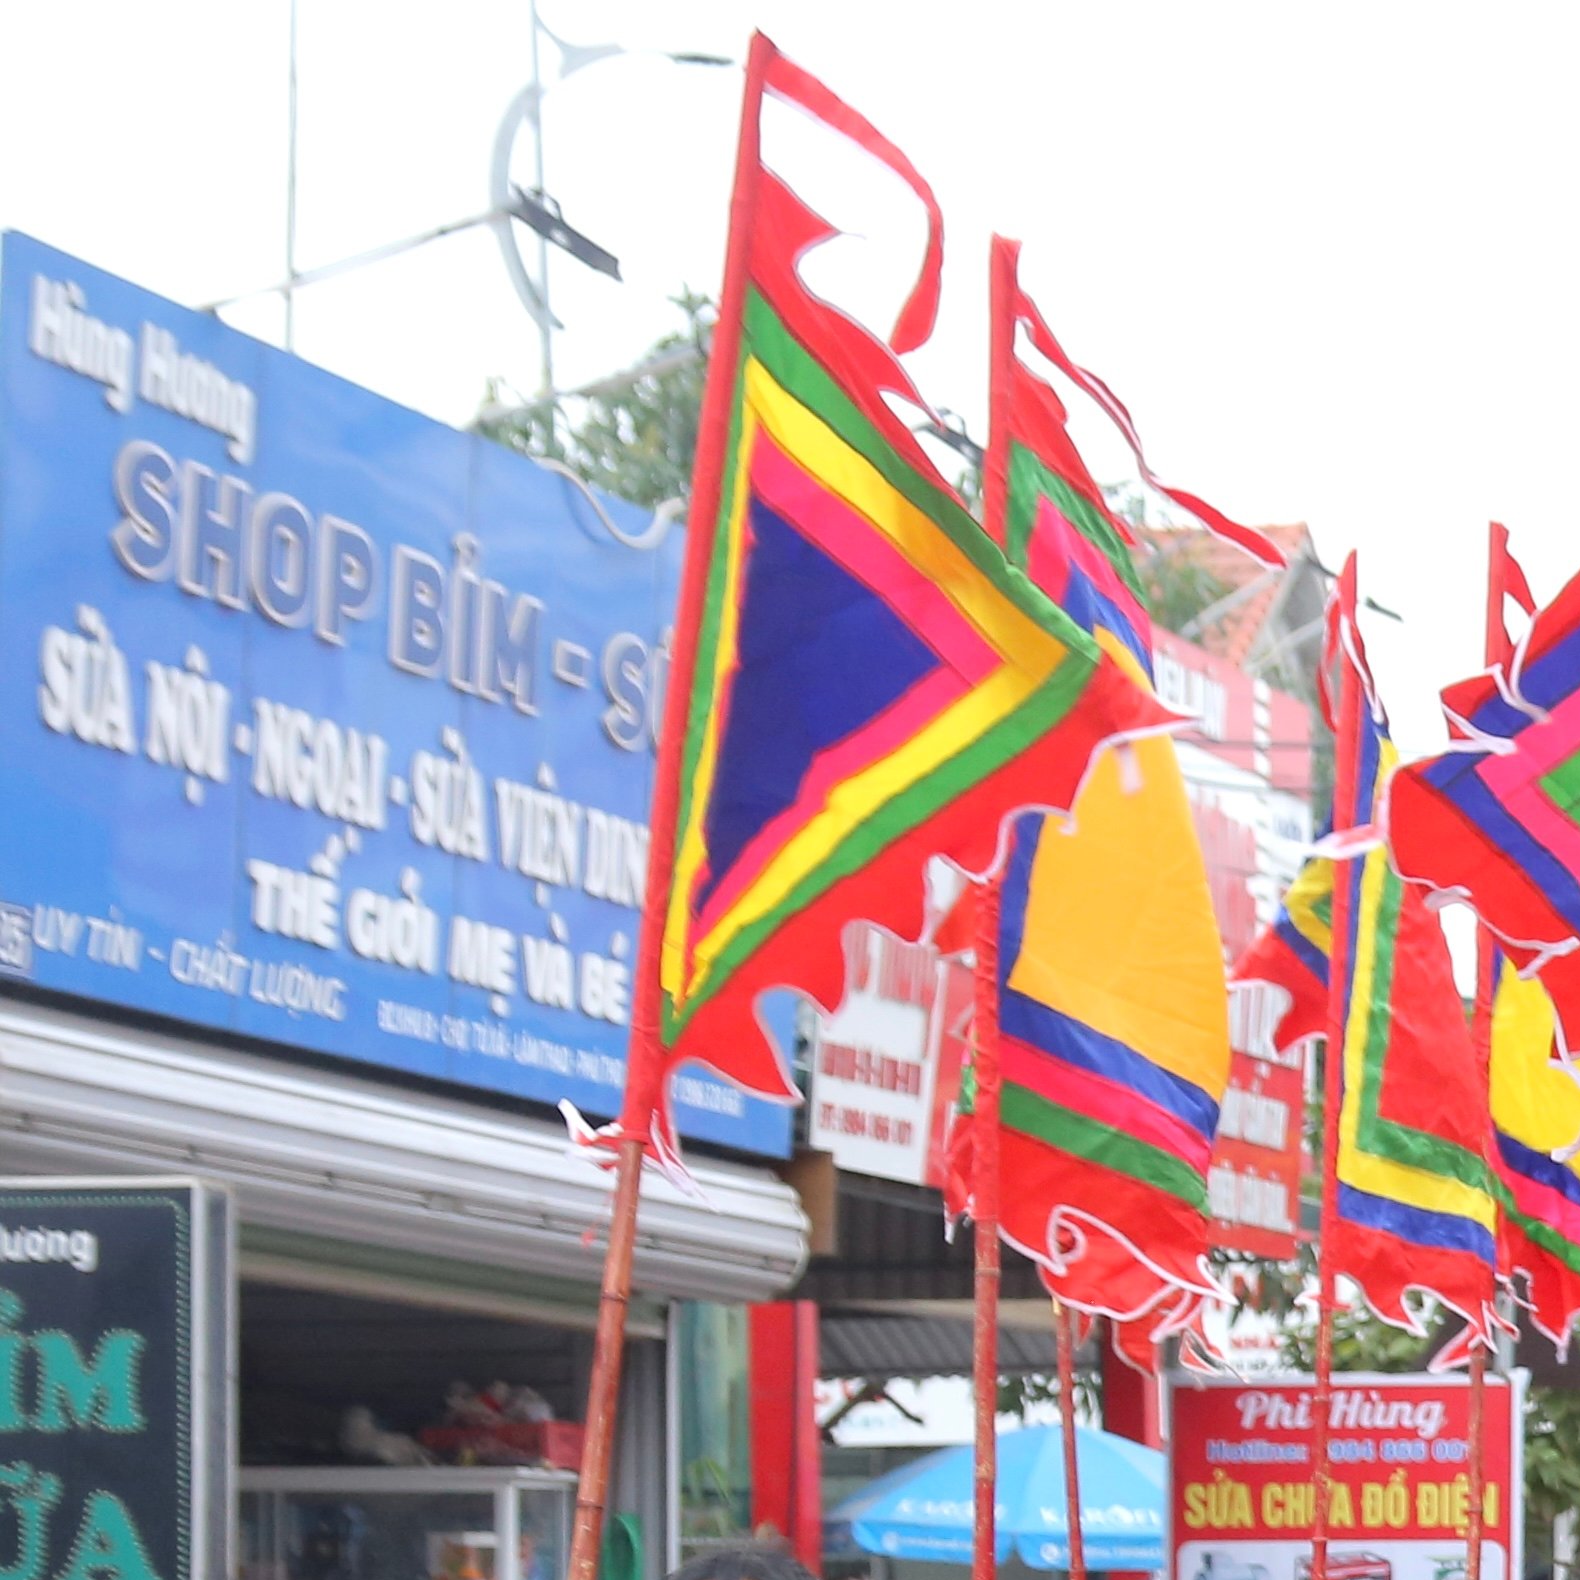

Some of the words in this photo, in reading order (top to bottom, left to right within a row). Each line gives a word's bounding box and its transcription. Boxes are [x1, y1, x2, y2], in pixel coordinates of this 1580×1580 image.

[112, 438, 380, 648] SHOP
[522, 912, 577, 1012] VÀ
[0, 1221, 99, 1274] ương
[1235, 1390, 1313, 1430] Phi
[1328, 1388, 1446, 1440] Hùng
